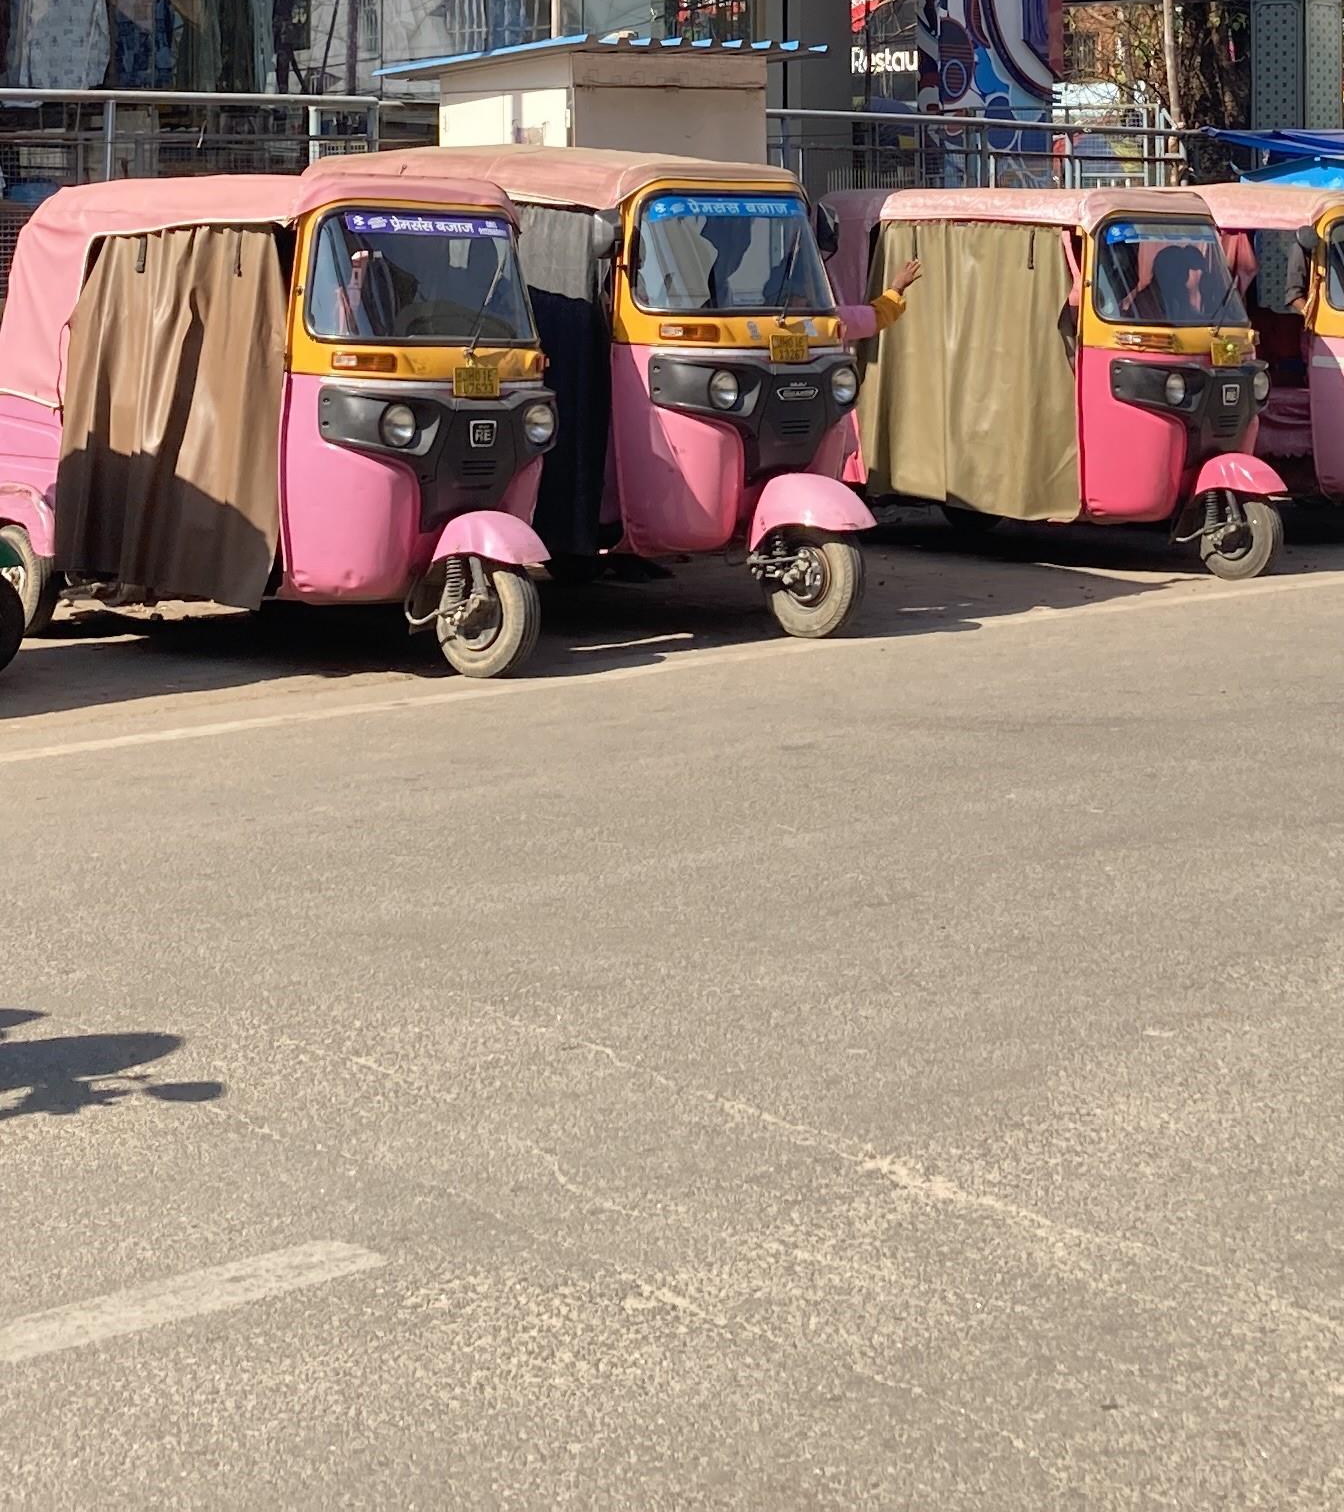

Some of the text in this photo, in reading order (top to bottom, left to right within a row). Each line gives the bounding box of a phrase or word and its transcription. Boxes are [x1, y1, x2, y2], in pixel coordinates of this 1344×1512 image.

[743, 202, 788, 215] बजाज
[434, 221, 475, 234] बजाज
[475, 429, 492, 442] RE
